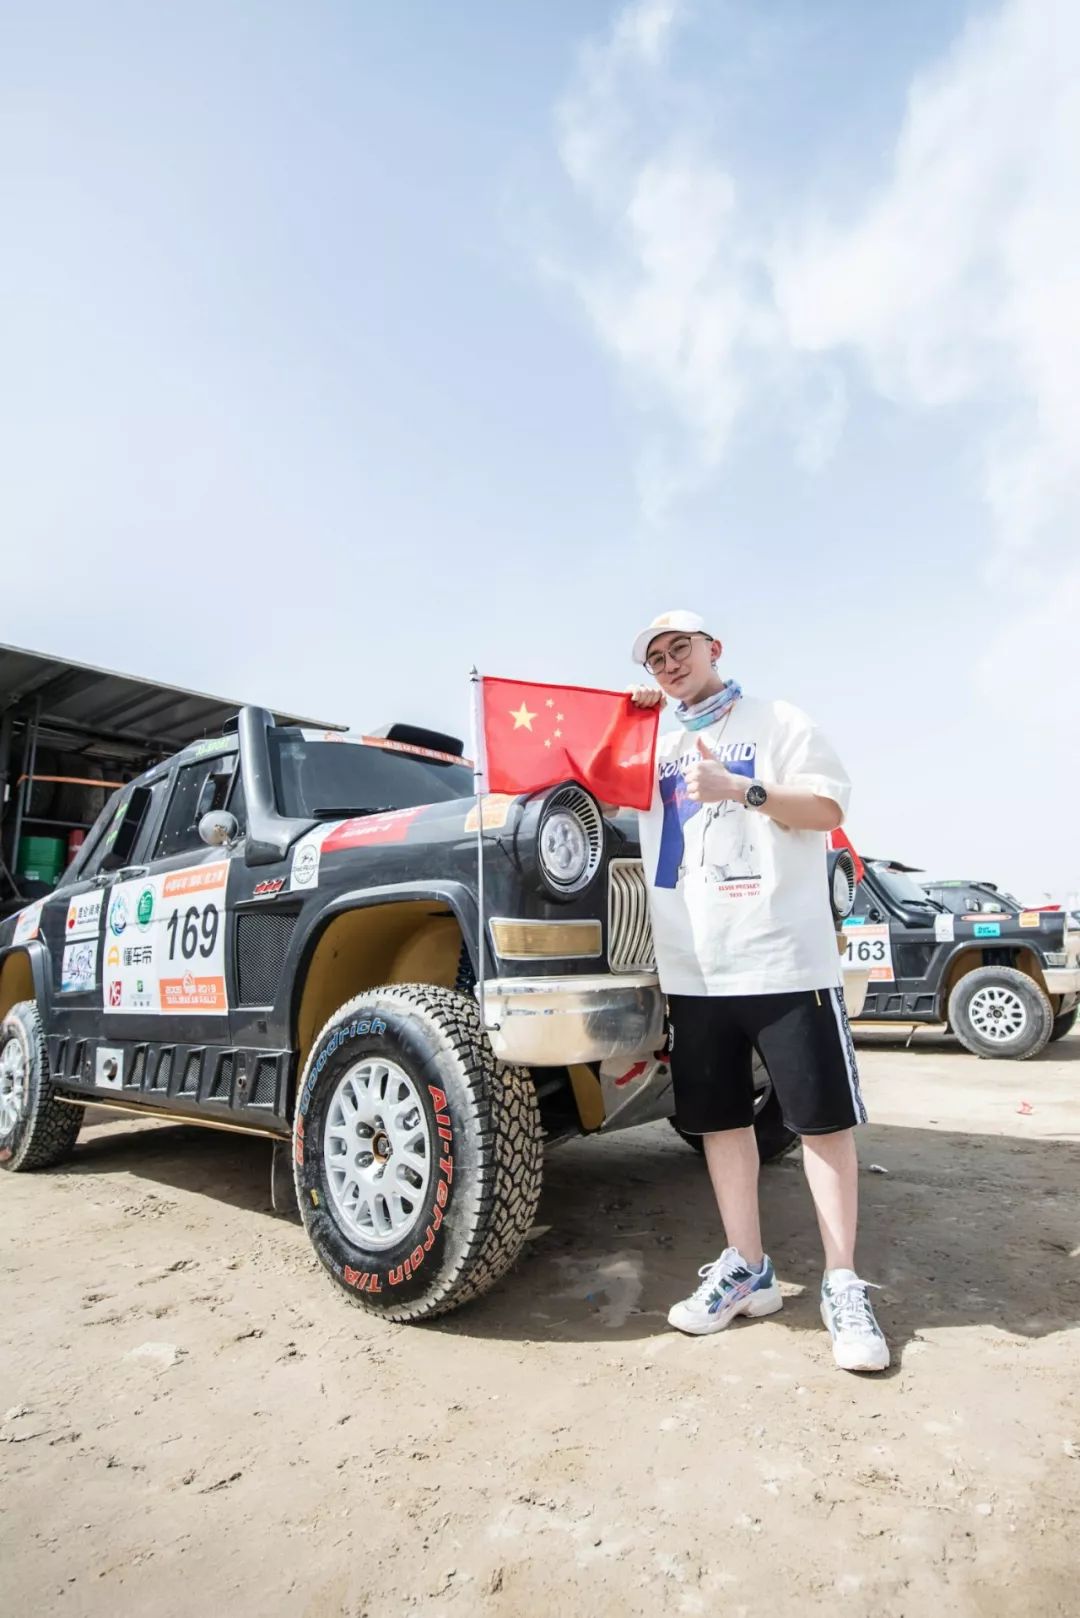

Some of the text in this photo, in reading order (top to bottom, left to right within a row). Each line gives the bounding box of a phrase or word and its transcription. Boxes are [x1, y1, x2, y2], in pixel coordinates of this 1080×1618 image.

[166, 903, 219, 960] 169
[846, 940, 885, 961] 163
[344, 1084, 453, 1293] All-Terrain T/A
